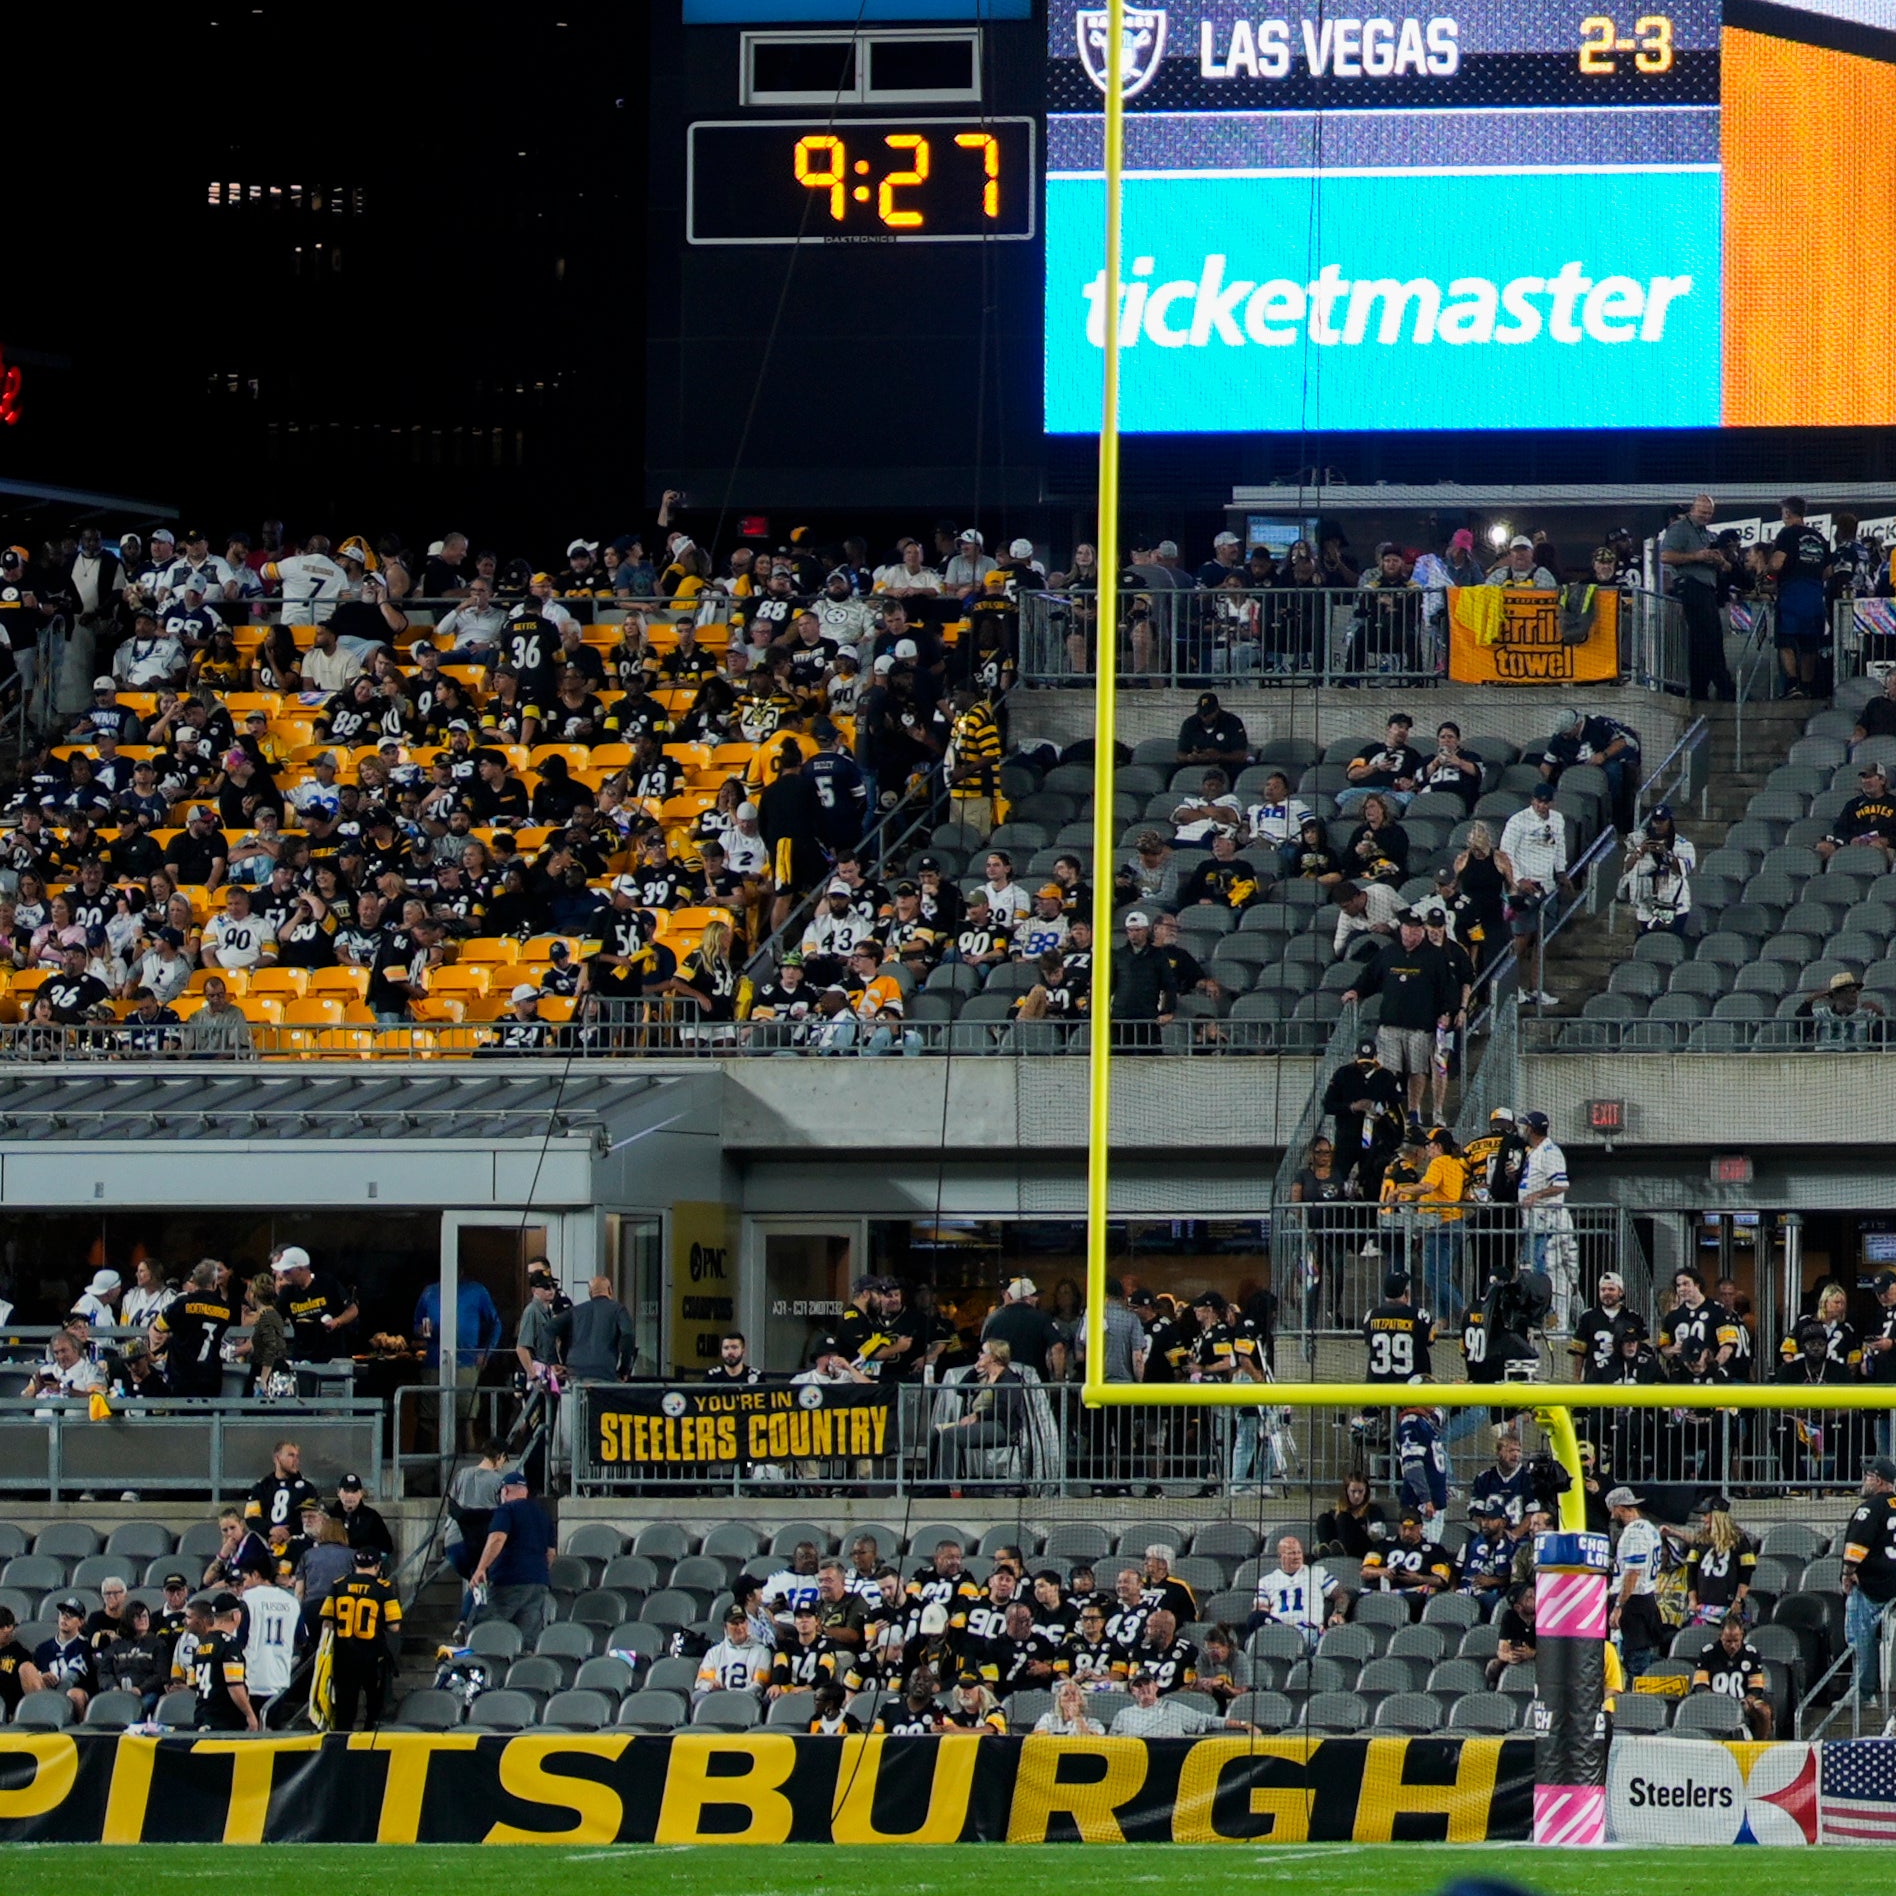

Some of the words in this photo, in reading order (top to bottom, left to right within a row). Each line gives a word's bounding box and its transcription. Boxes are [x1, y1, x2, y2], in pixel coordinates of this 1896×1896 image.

[1198, 20, 1293, 77] LAS
[1300, 19, 1459, 76] VEGAS
[1578, 16, 1673, 74] 2-3
[794, 134, 999, 227] 9:27
[1082, 254, 1691, 348] ticketmaster
[756, 601, 787, 619] 88
[511, 636, 541, 668] 36
[1494, 645, 1573, 678] towel
[1592, 1104, 1619, 1125] EXIT
[289, 1297, 327, 1314] Steelers
[1371, 1318, 1414, 1331] FITZPATRICK
[197, 1323, 218, 1361] 7
[1371, 1333, 1414, 1375] 39
[1465, 1326, 1486, 1363] 90
[694, 1392, 765, 1412] YOU'RE
[771, 1391, 792, 1408] IN
[601, 1412, 737, 1461] STEELERS
[748, 1406, 888, 1458] COUNTRY
[271, 1489, 289, 1524] 8
[1700, 1552, 1729, 1577] 43
[347, 1583, 370, 1594] WATT
[1279, 1590, 1306, 1613] 11
[264, 1616, 284, 1646] 11
[336, 1597, 378, 1639] 90
[1629, 1777, 1733, 1808] Steelers
